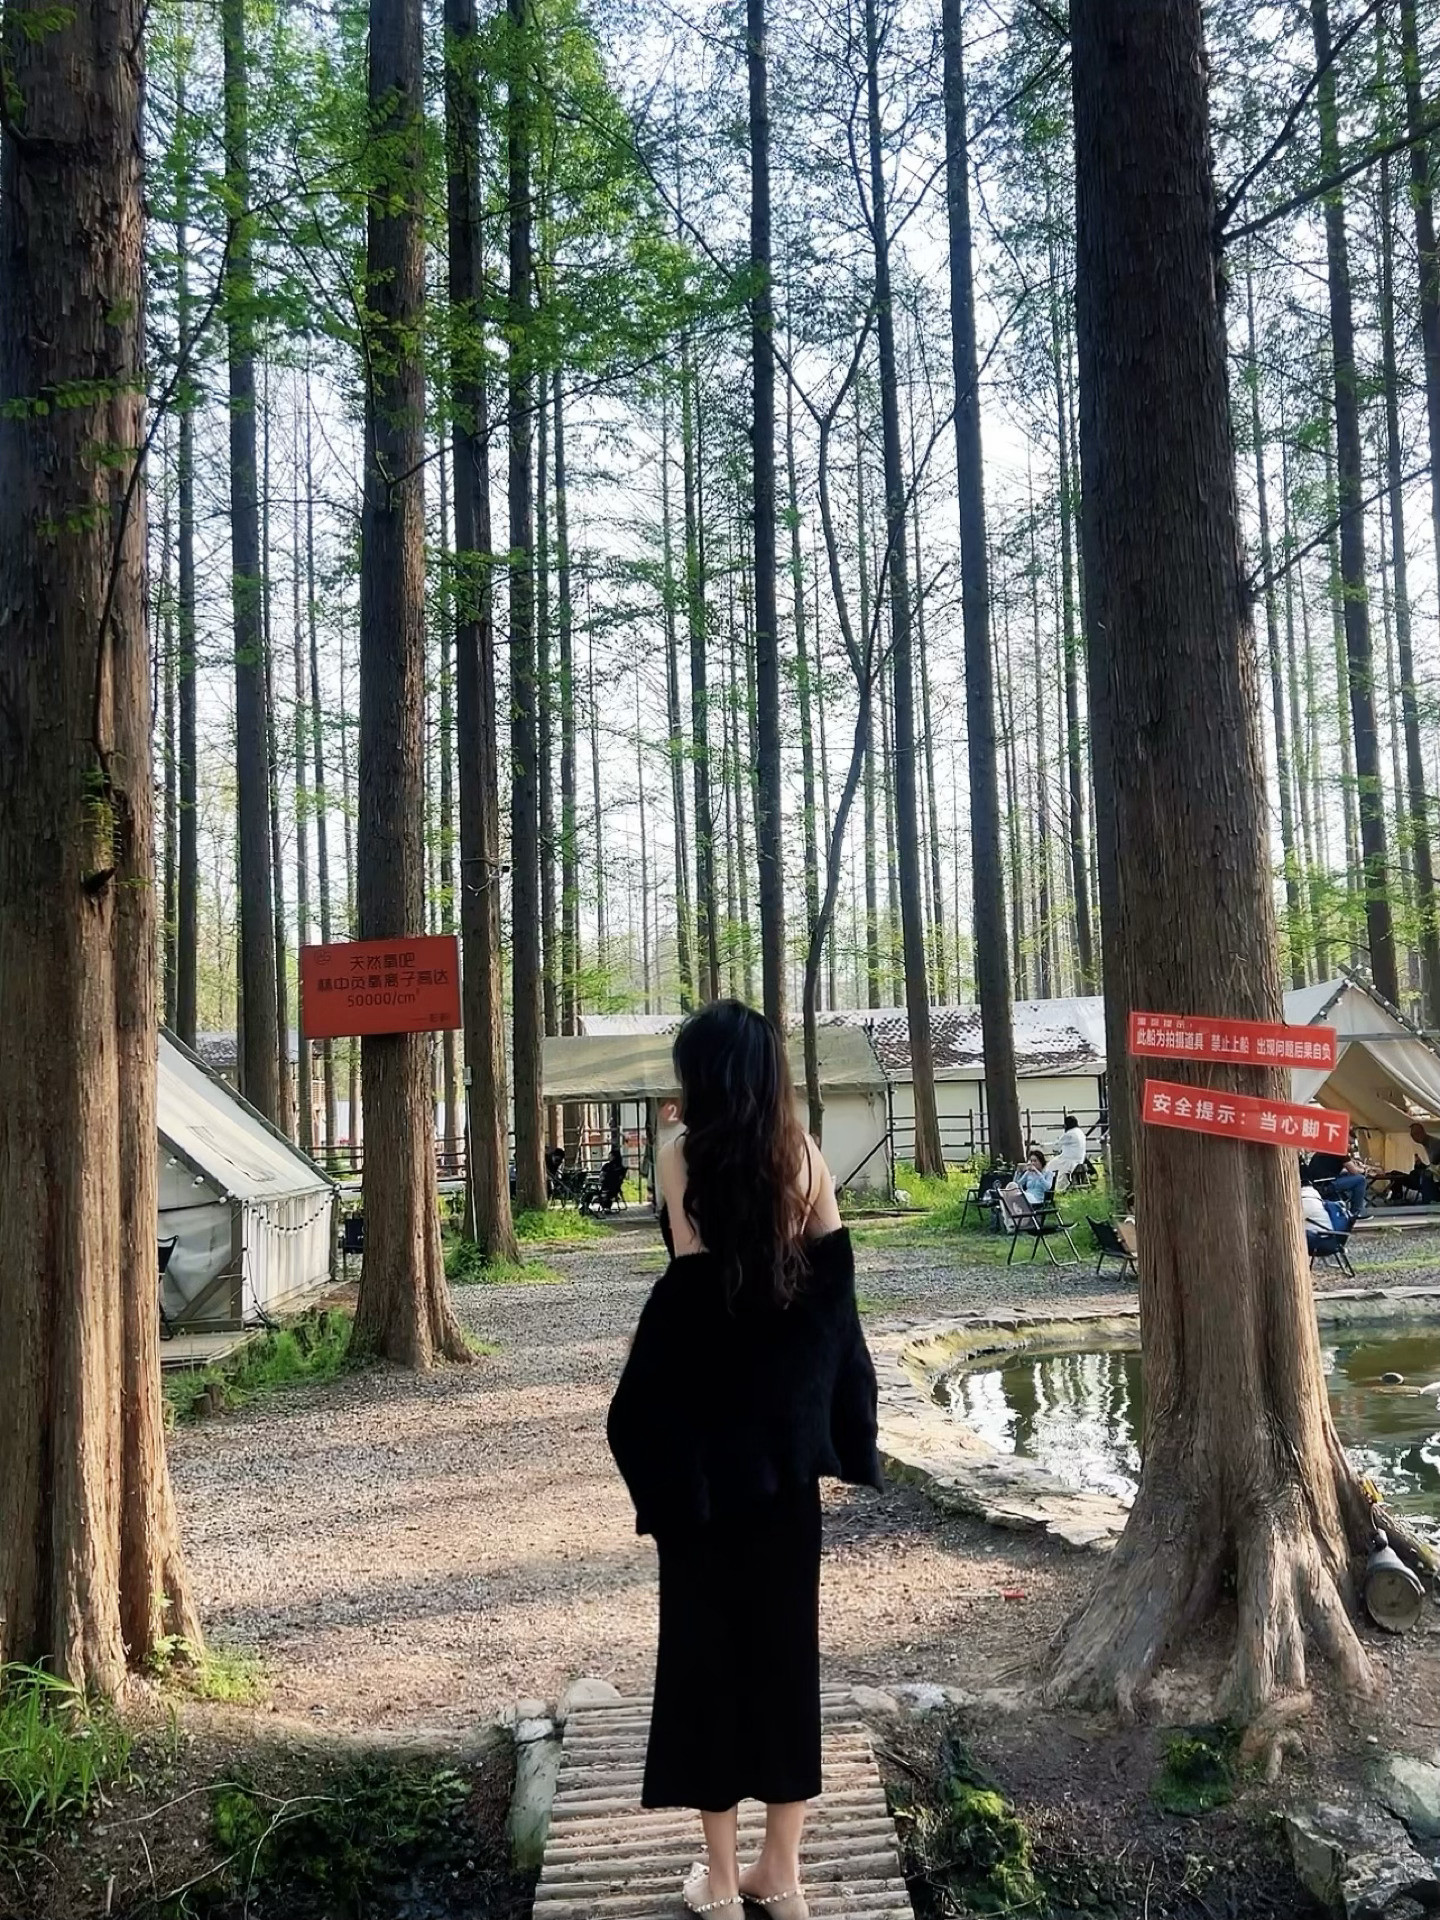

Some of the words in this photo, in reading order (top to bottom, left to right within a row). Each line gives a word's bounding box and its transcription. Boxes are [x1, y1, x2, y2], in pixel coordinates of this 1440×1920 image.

[350, 952, 415, 971] 天然氧吧
[317, 969, 449, 993] 林中负氧离子高达
[1136, 1028, 1204, 1051] 此船为拍摄道具
[1211, 1034, 1249, 1054] 禁止上船
[1257, 1039, 1331, 1061] 出现问题后果自负
